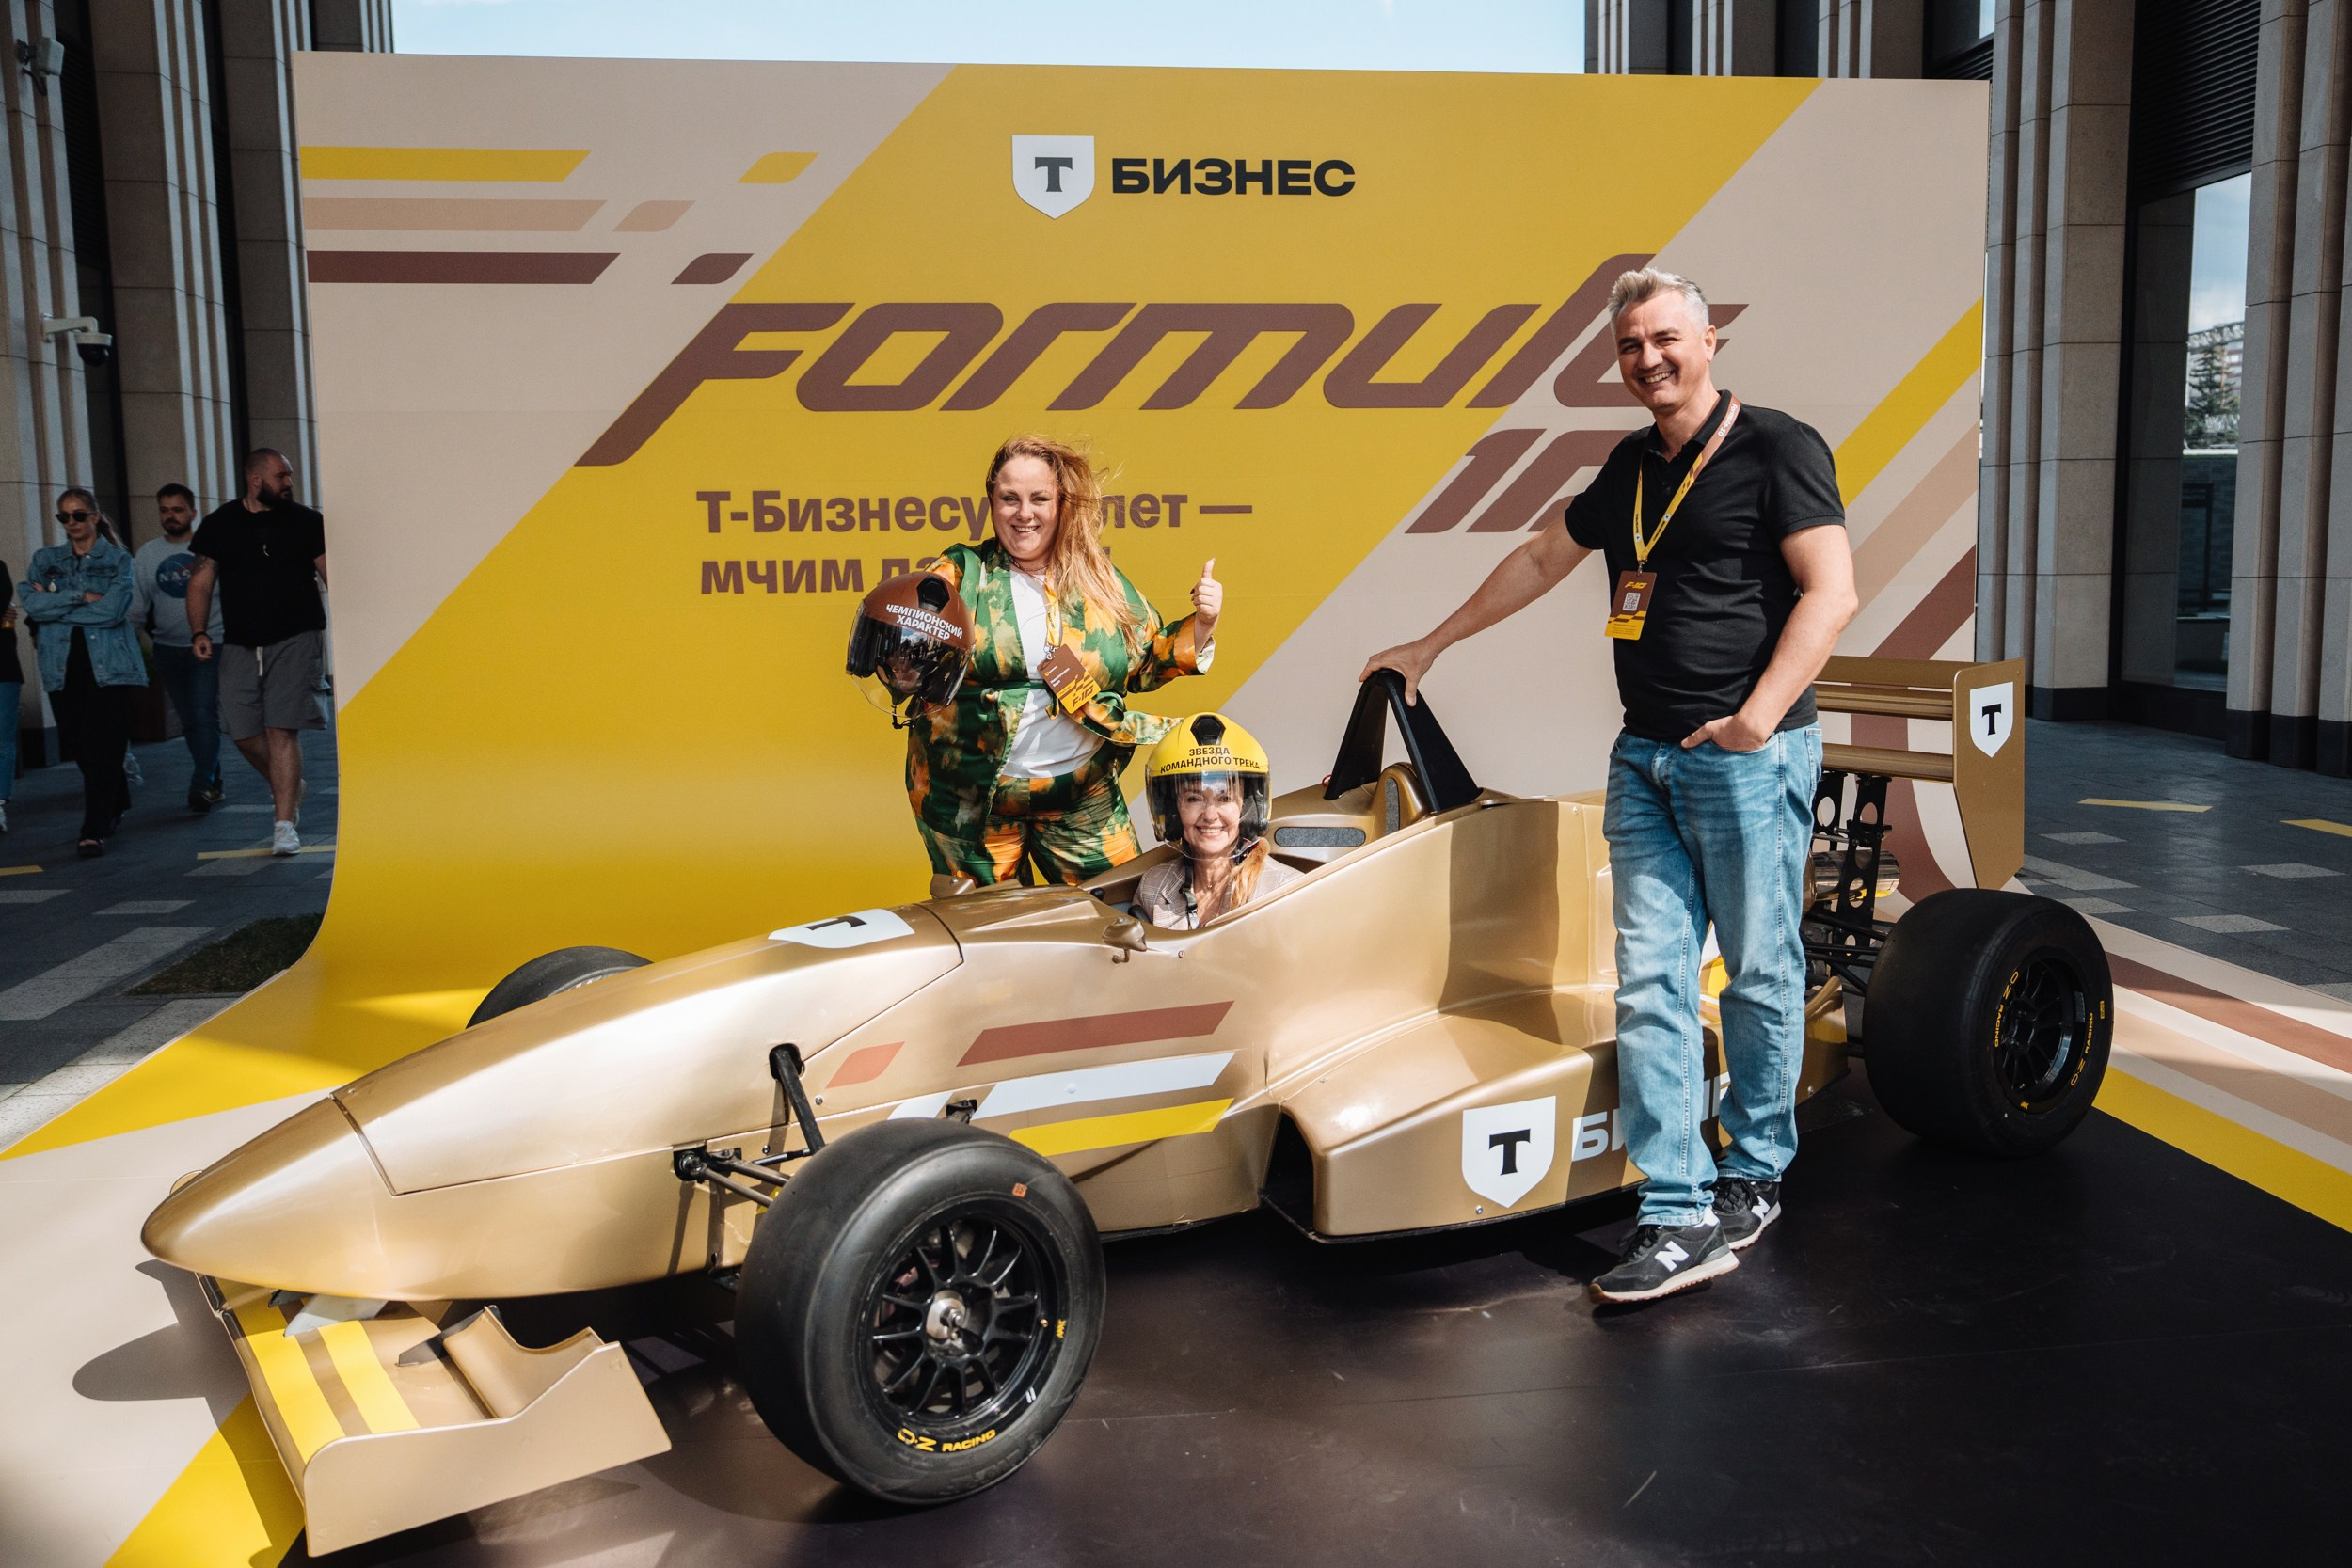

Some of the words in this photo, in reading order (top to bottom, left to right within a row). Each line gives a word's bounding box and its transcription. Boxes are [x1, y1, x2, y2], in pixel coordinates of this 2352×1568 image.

[1112, 158, 1356, 197] БИЗНЕС
[696, 490, 992, 542] Т-Бизнесу
[159, 569, 191, 582] NAS
[701, 555, 865, 595] мчим
[886, 603, 963, 640] ЧЕМПИОНСКИЙ
[897, 614, 951, 641] ХАРАКТЕР
[1160, 756, 1232, 773] КОМАНДНОГО
[1233, 757, 1261, 769] ТРЕКА
[1189, 747, 1230, 757] ЗВЕЗДА
[1994, 1004, 2004, 1048] RACING
[2085, 1012, 2094, 1054] RACING
[942, 1429, 996, 1452] RACING
